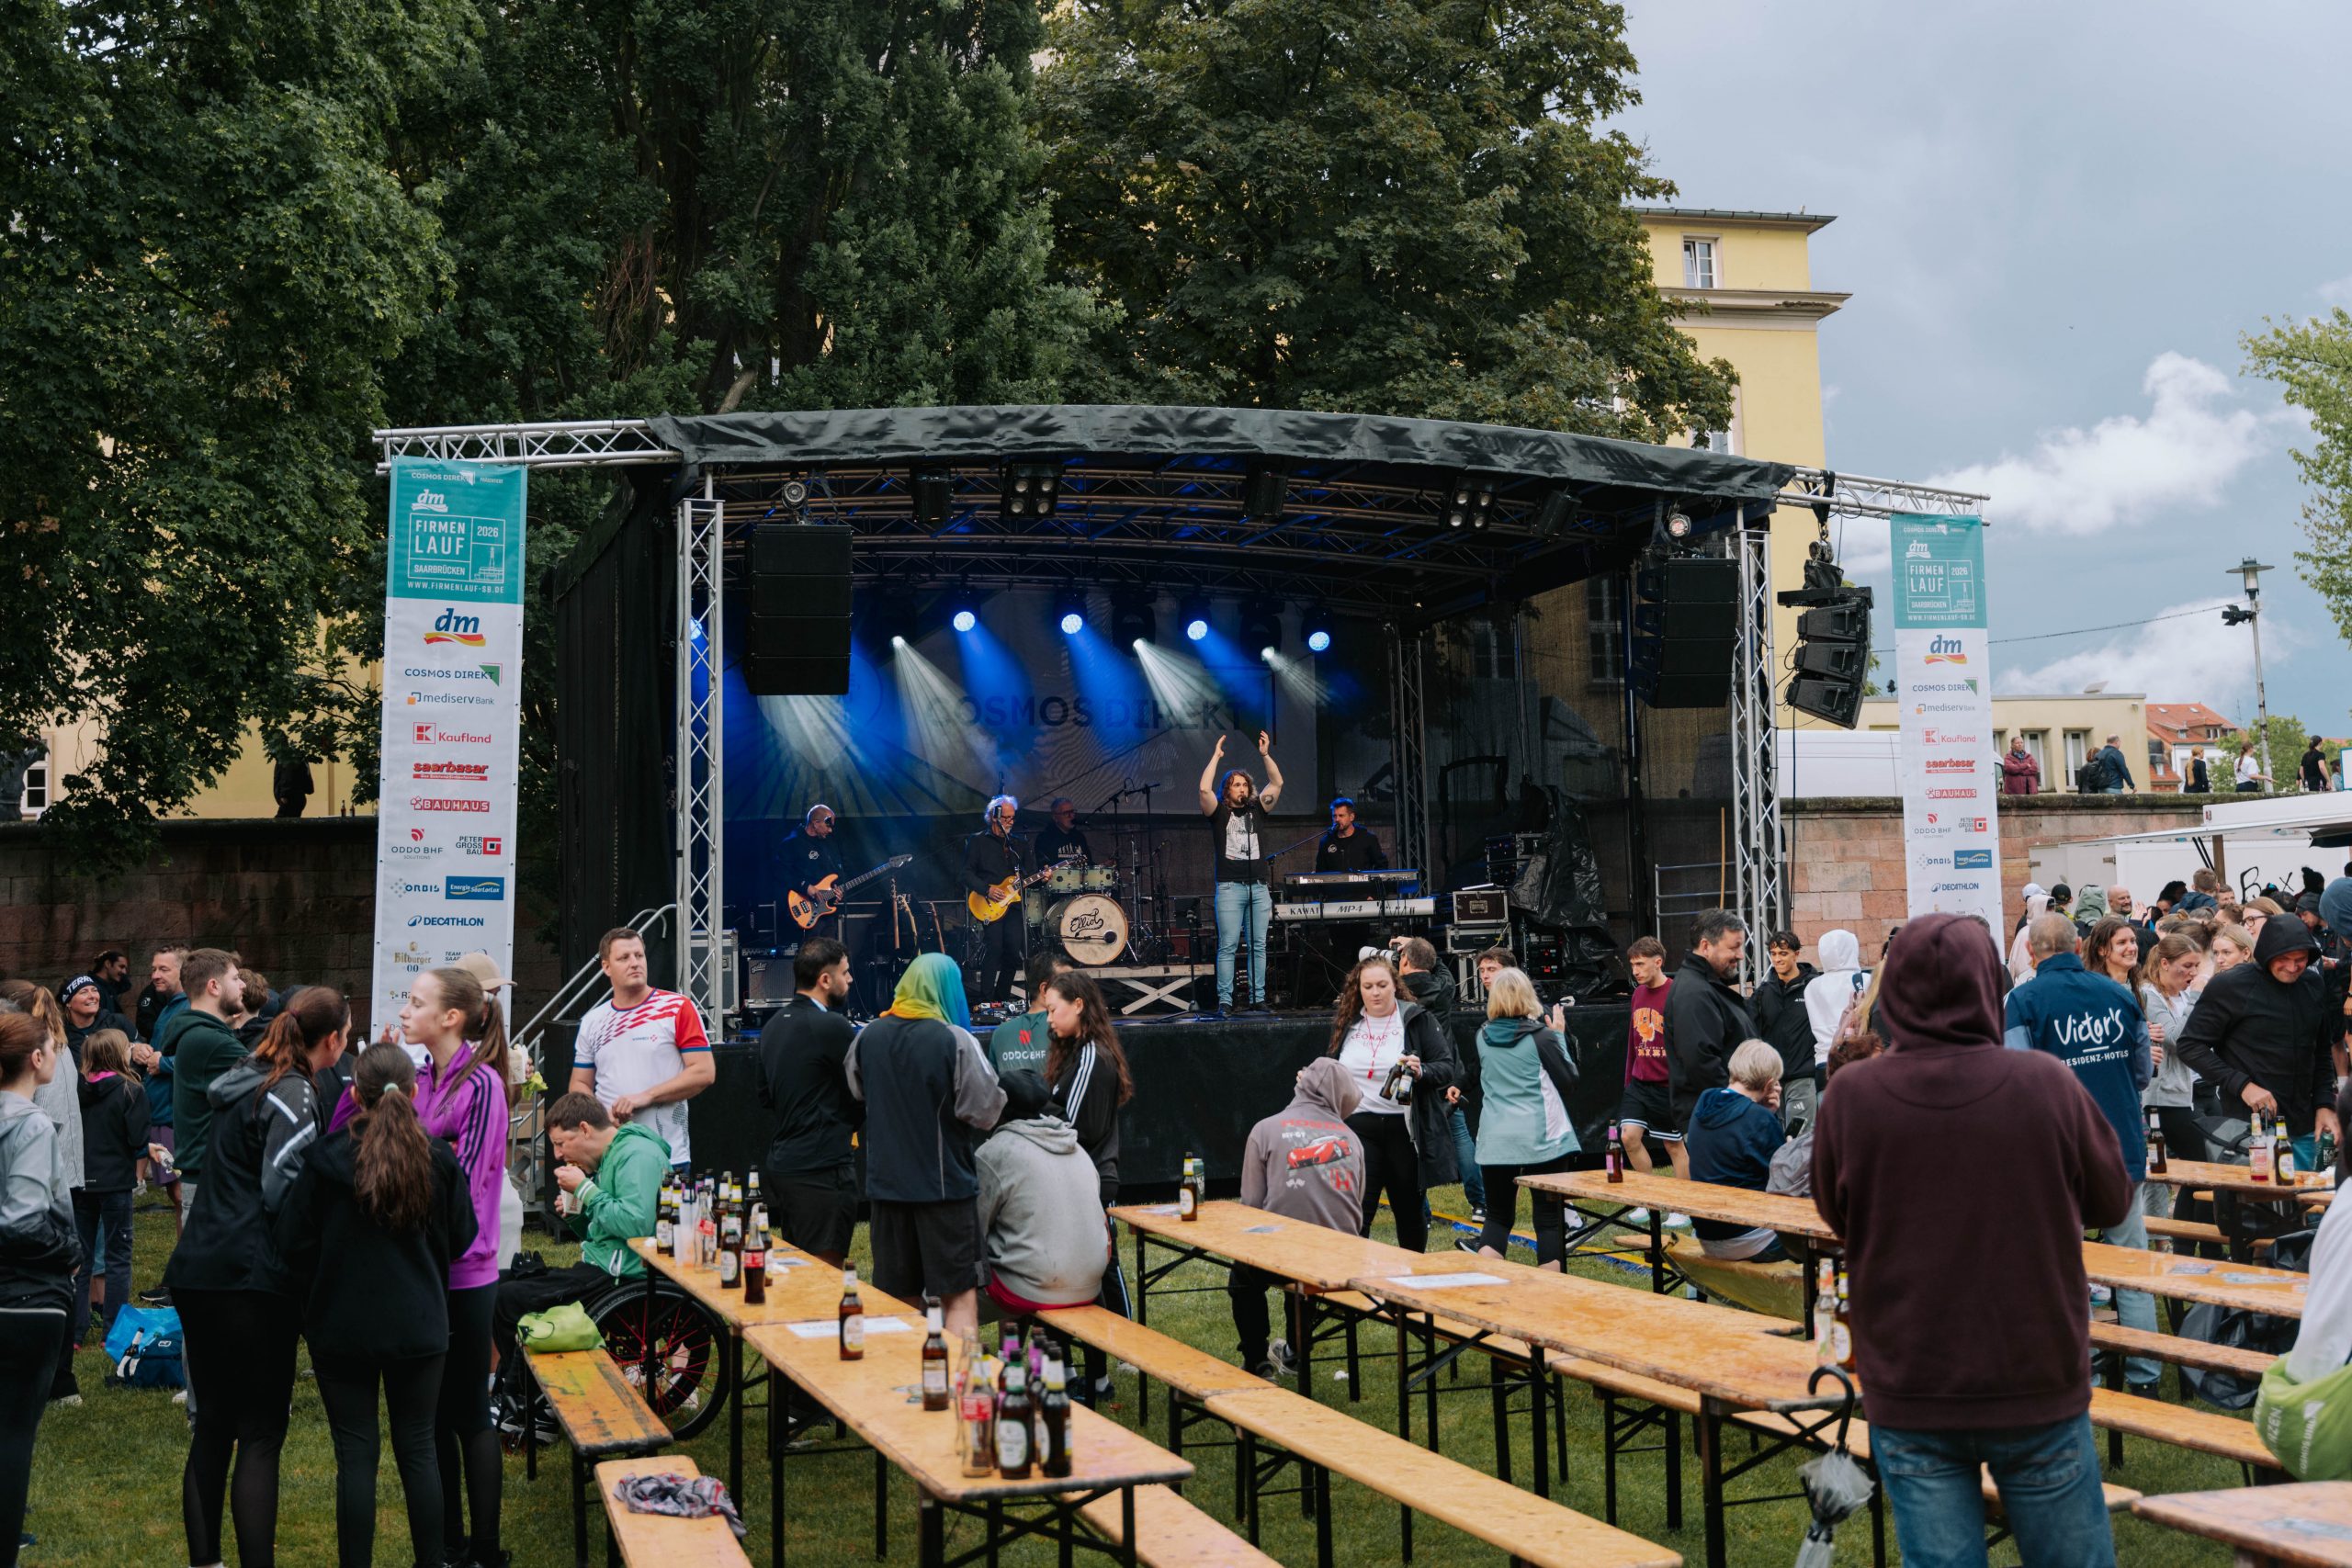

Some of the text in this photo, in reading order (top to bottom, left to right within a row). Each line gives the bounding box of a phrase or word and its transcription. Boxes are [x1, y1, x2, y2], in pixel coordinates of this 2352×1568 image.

[412, 472, 441, 480] COSMOS
[417, 489, 445, 504] dm
[415, 520, 466, 534] FIRMEN
[477, 525, 499, 537] 2026
[415, 535, 465, 556] LAUF
[1909, 540, 1928, 551] dm
[413, 564, 466, 576] SAARBRÜCKEN
[1910, 565, 1943, 575] FIRMEN
[407, 581, 504, 593] WWW.FIRMENLAUF-SB.DE
[1910, 578, 1944, 592] LAUF
[435, 608, 480, 634] dm
[1930, 635, 1962, 653] dm
[404, 668, 494, 680] COSMOS DIREKT
[423, 693, 495, 705] mediserv Bank
[1928, 703, 1963, 712] mediserv
[438, 732, 492, 743] Kaufland
[1941, 735, 1976, 743] Kaufland
[413, 761, 489, 773] saarbasar
[1934, 789, 1976, 798] BAUHAUS
[423, 799, 490, 812] BAUHAUS
[1941, 883, 1980, 891] DECATHLON
[1290, 907, 1319, 915] KAWAI
[424, 918, 484, 926] DECATHLON
[394, 952, 432, 964] Bitburger
[2054, 1008, 2124, 1045] Victor's
